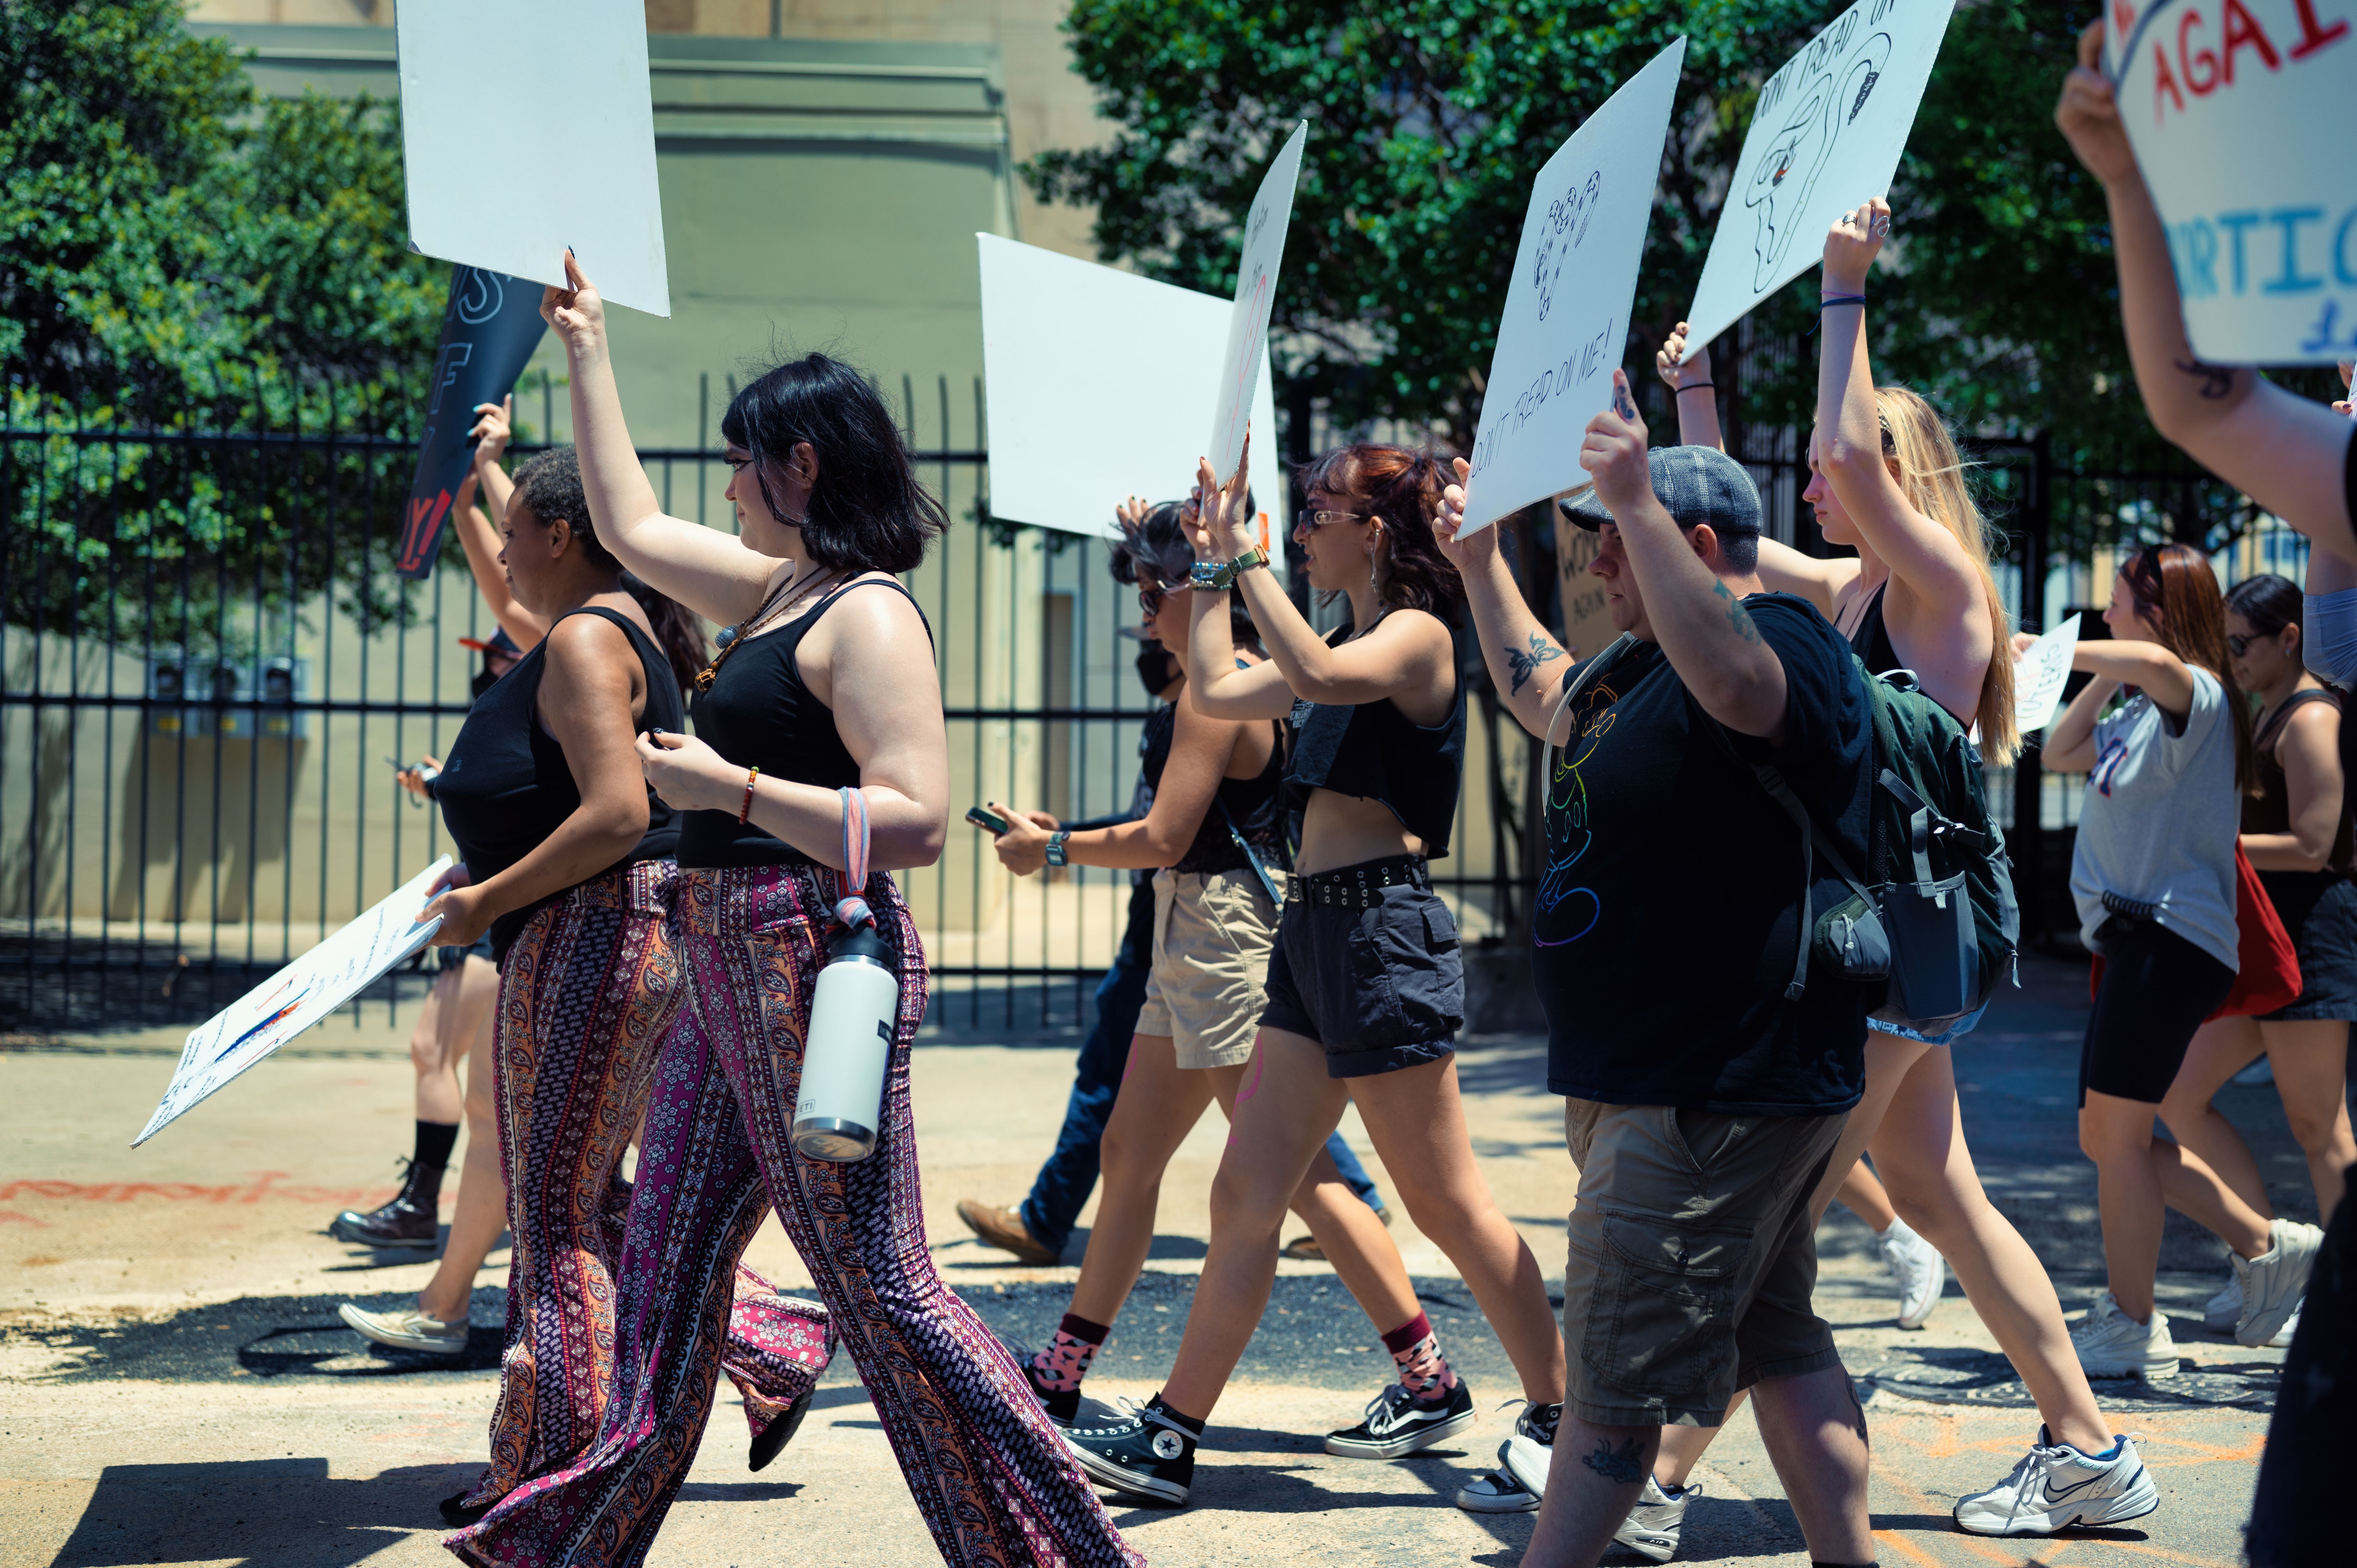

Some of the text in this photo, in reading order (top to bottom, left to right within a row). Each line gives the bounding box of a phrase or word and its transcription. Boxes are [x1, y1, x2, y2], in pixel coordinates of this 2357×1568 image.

[1797, 9, 1858, 91] TREAD
[1472, 318, 1613, 478] DON'T TREAD ON ME!
